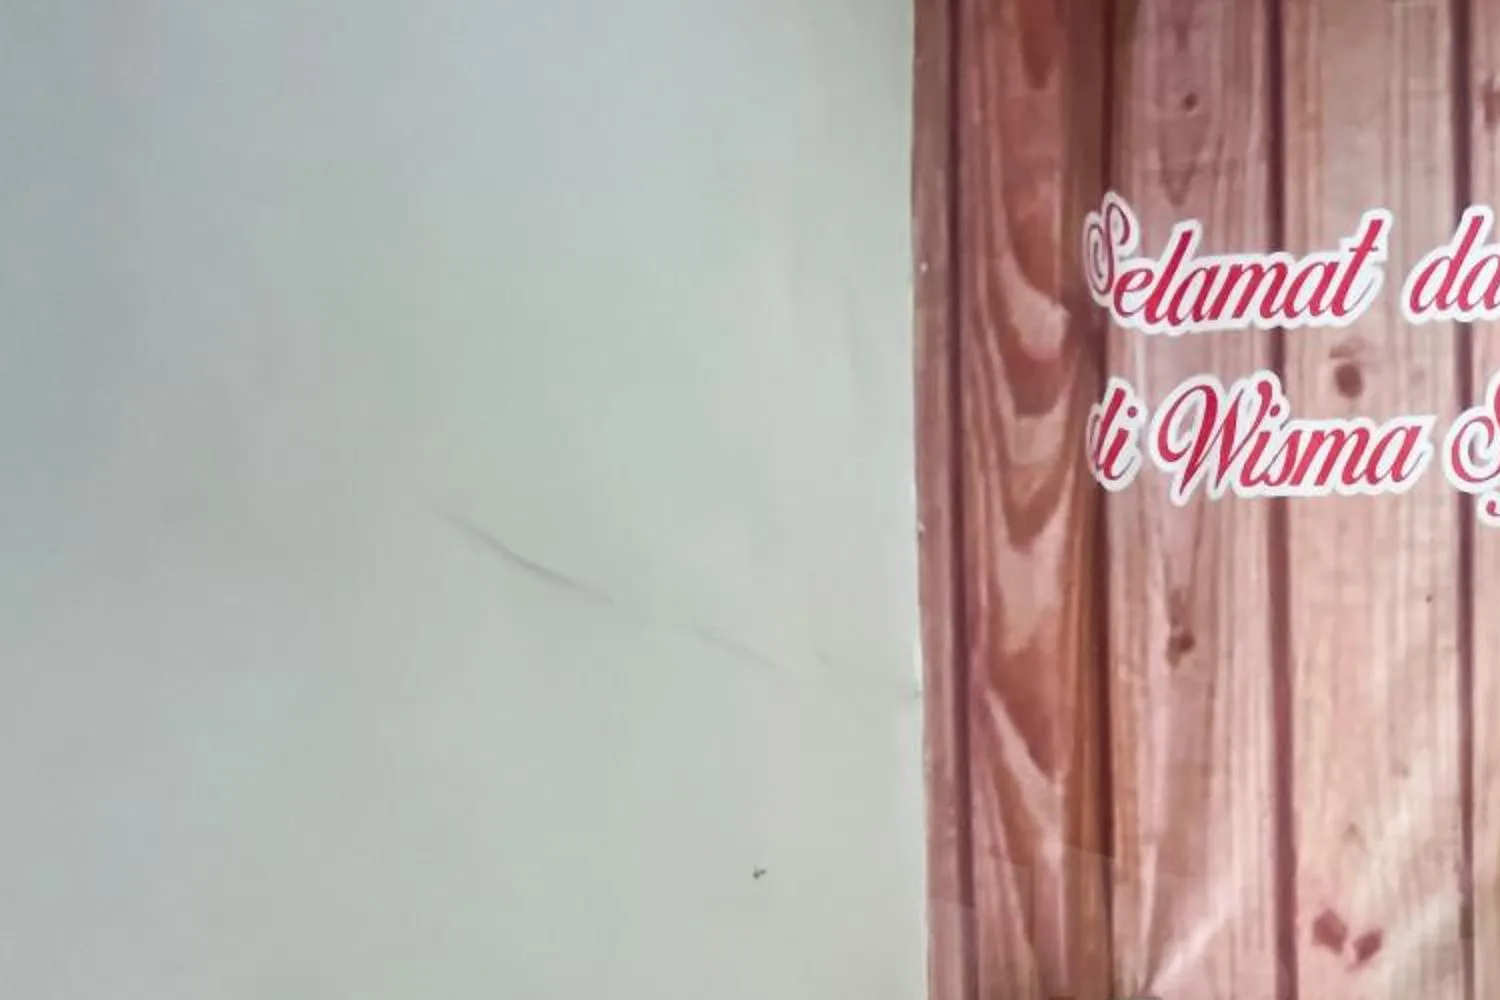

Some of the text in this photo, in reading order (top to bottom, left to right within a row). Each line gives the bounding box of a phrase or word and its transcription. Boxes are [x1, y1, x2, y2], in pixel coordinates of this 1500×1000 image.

[1087, 203, 1378, 325] Selamat
[1088, 388, 1135, 480] di
[1156, 380, 1424, 495] Wisma
